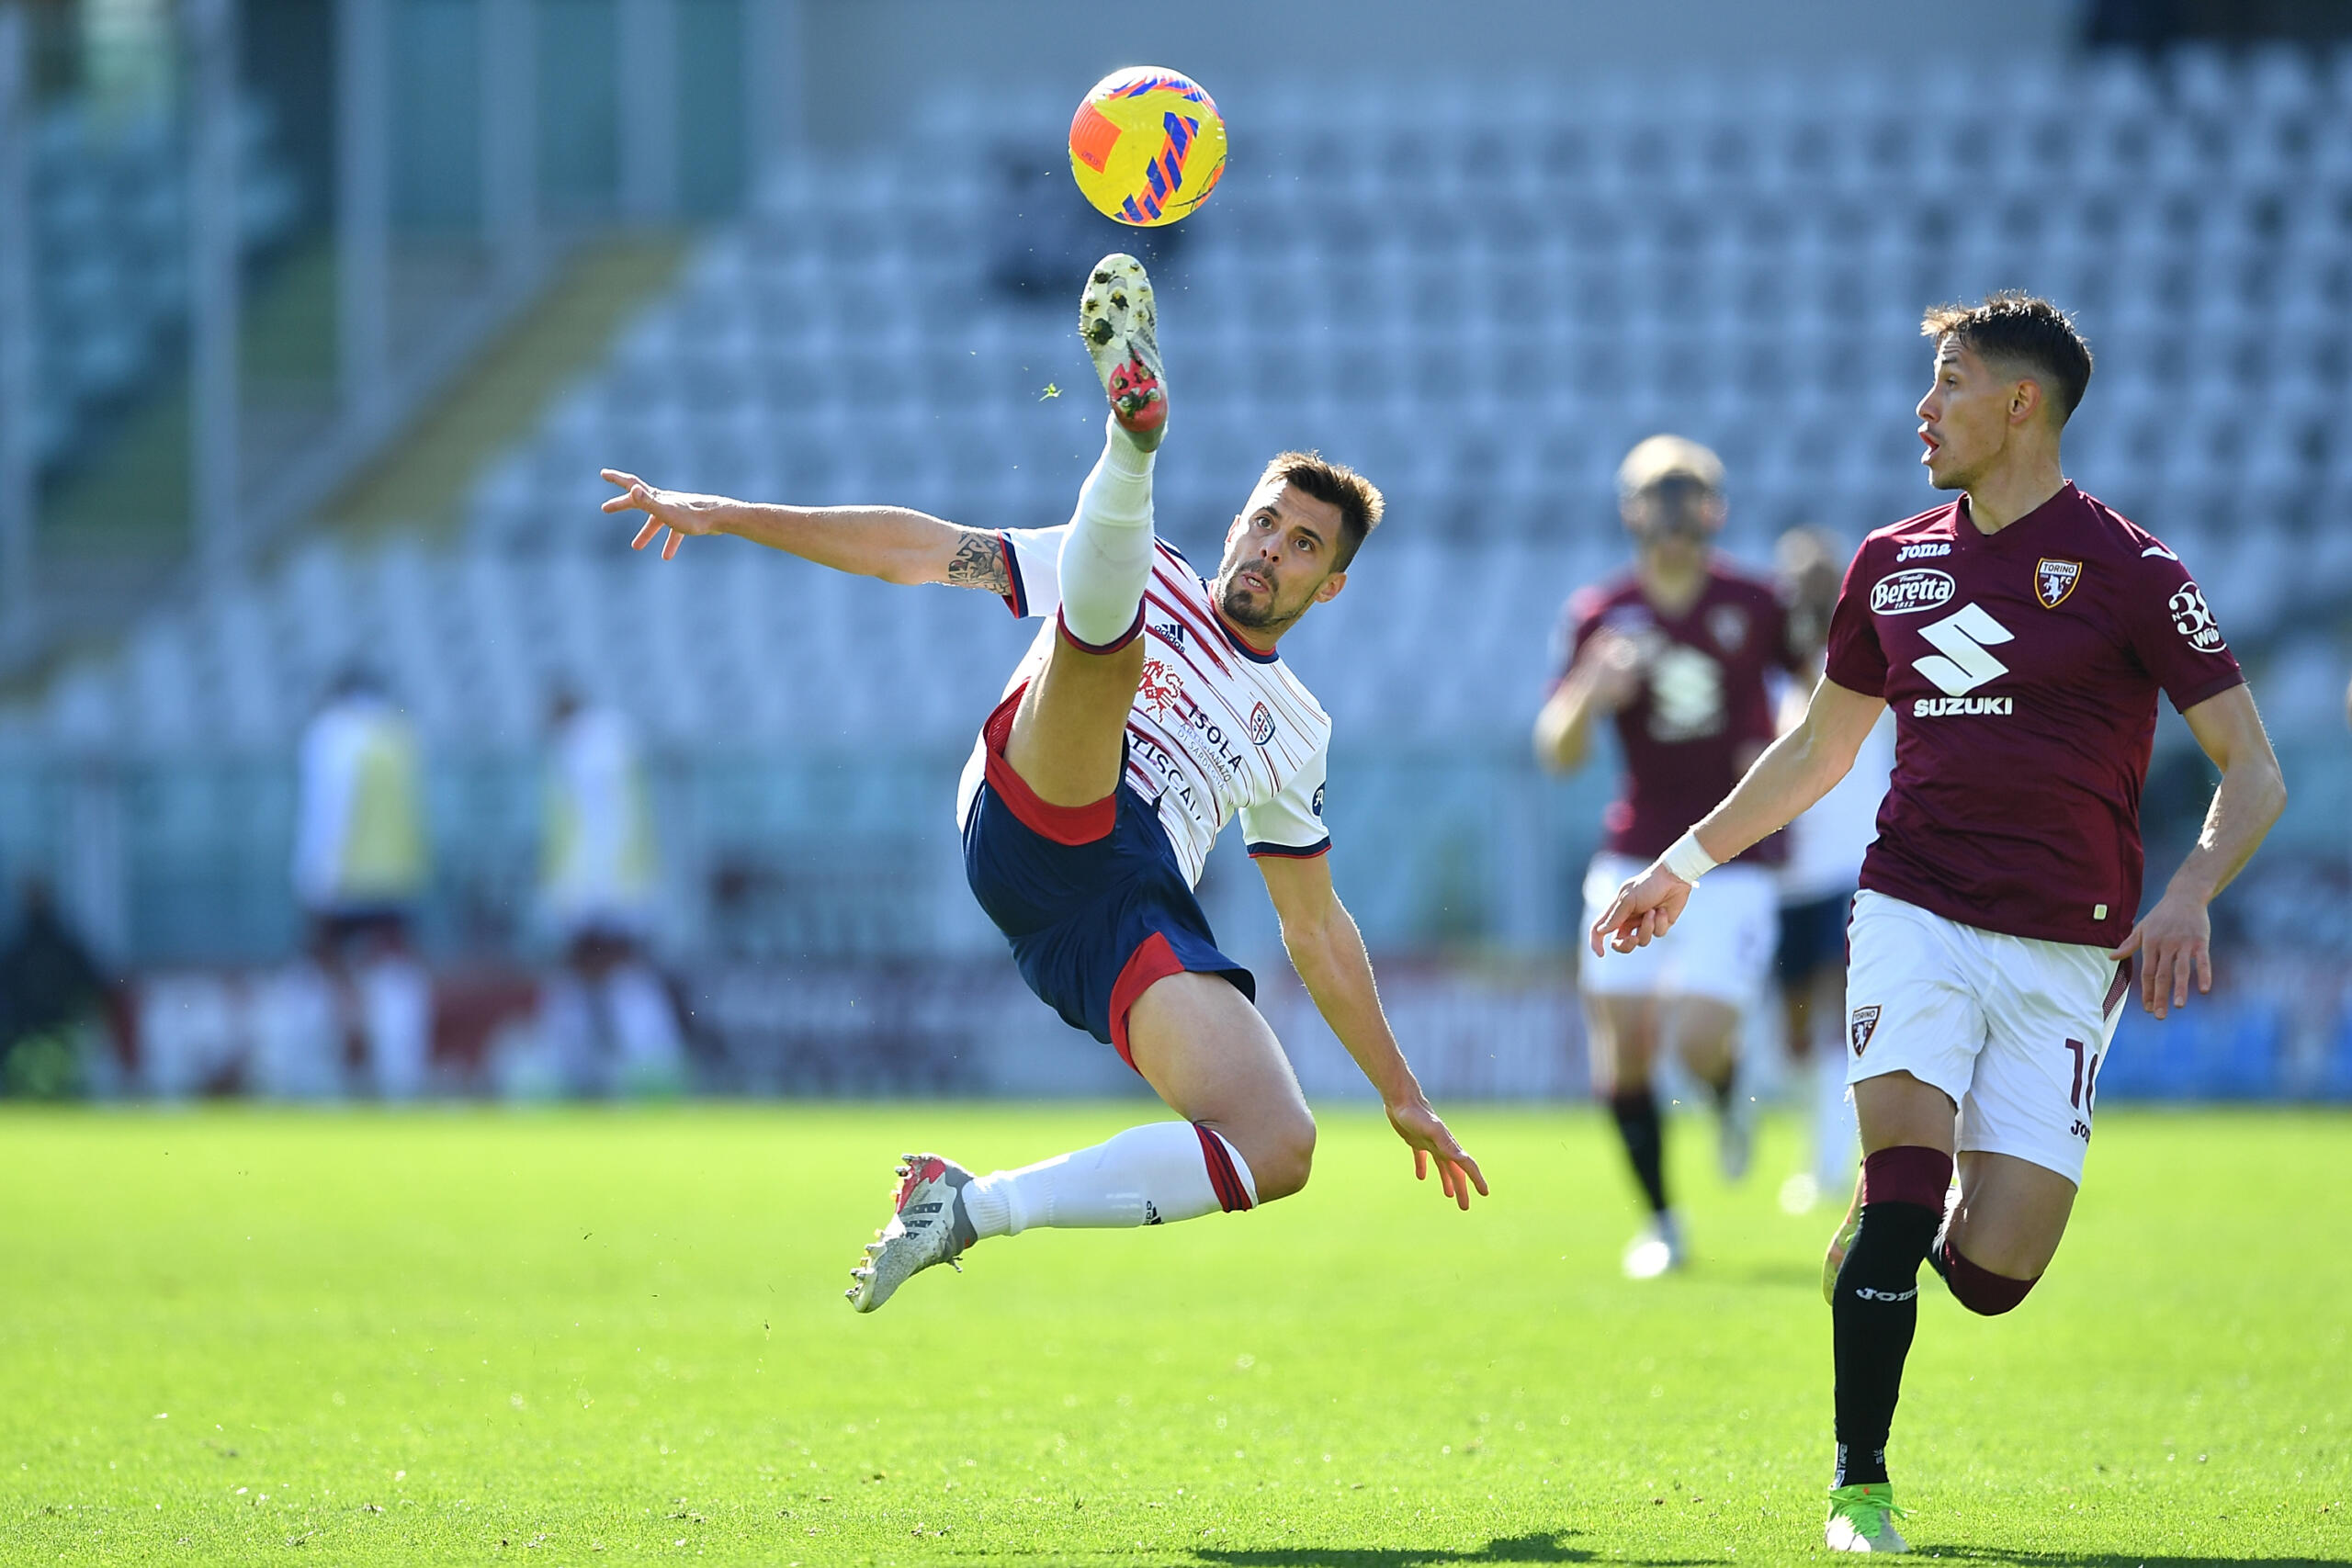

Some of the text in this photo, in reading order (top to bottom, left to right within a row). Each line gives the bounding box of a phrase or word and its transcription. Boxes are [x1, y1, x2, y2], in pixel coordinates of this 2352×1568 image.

[1896, 543, 1951, 562] Joma
[2043, 563, 2075, 574] TORINO
[2060, 576, 2073, 585] FC
[1873, 577, 1951, 610] Beretta
[1154, 625, 1186, 653] adidas
[1913, 696, 2013, 718] SUZUKI
[1188, 705, 1242, 773] ISOLA
